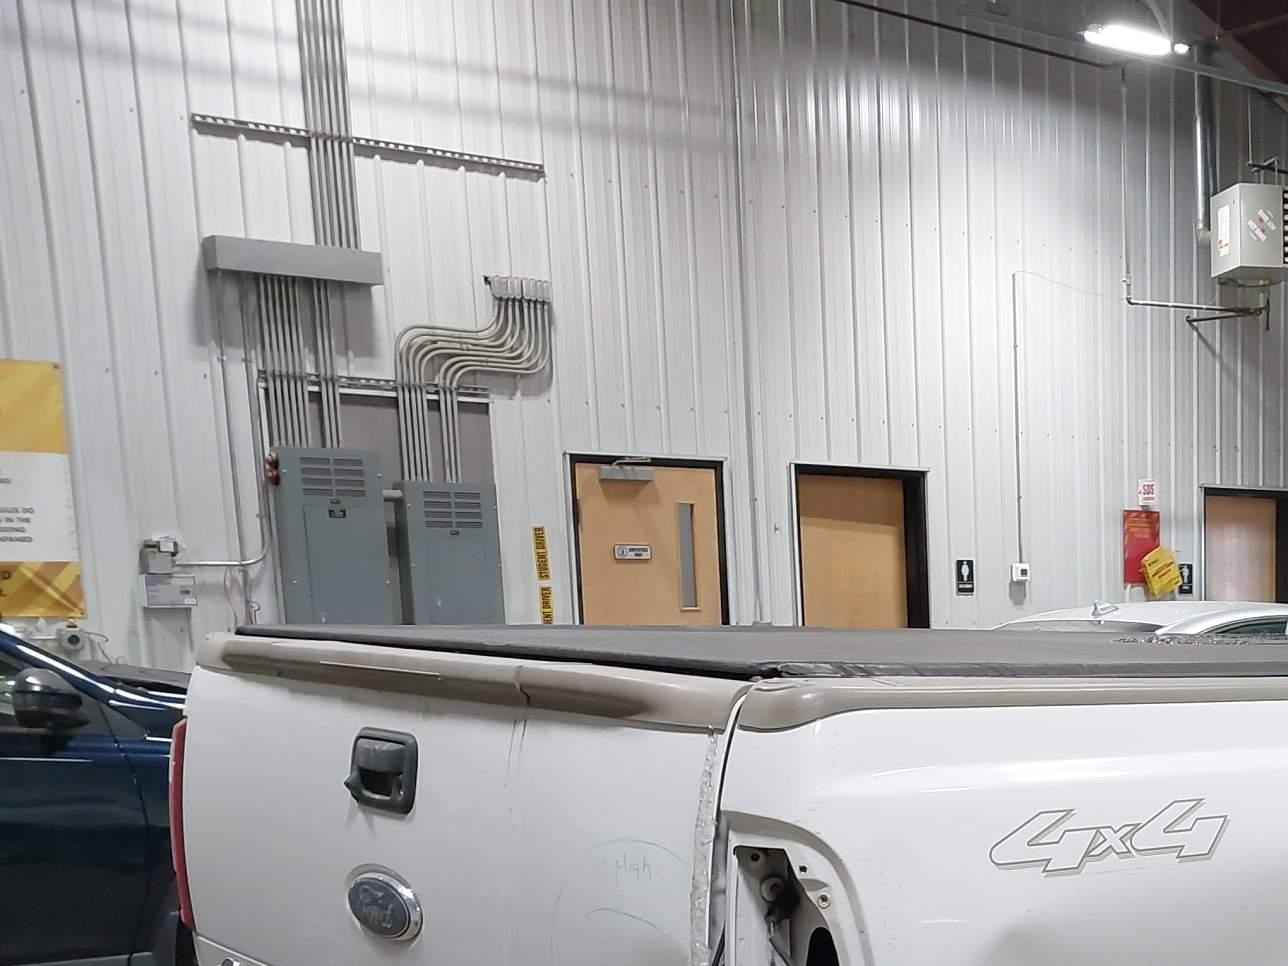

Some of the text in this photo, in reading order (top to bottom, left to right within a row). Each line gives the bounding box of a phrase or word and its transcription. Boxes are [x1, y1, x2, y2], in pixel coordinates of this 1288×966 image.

[1143, 483, 1155, 495] SDS
[534, 527, 549, 579] STUDENT DRIVER
[989, 797, 1230, 877] 4x4
